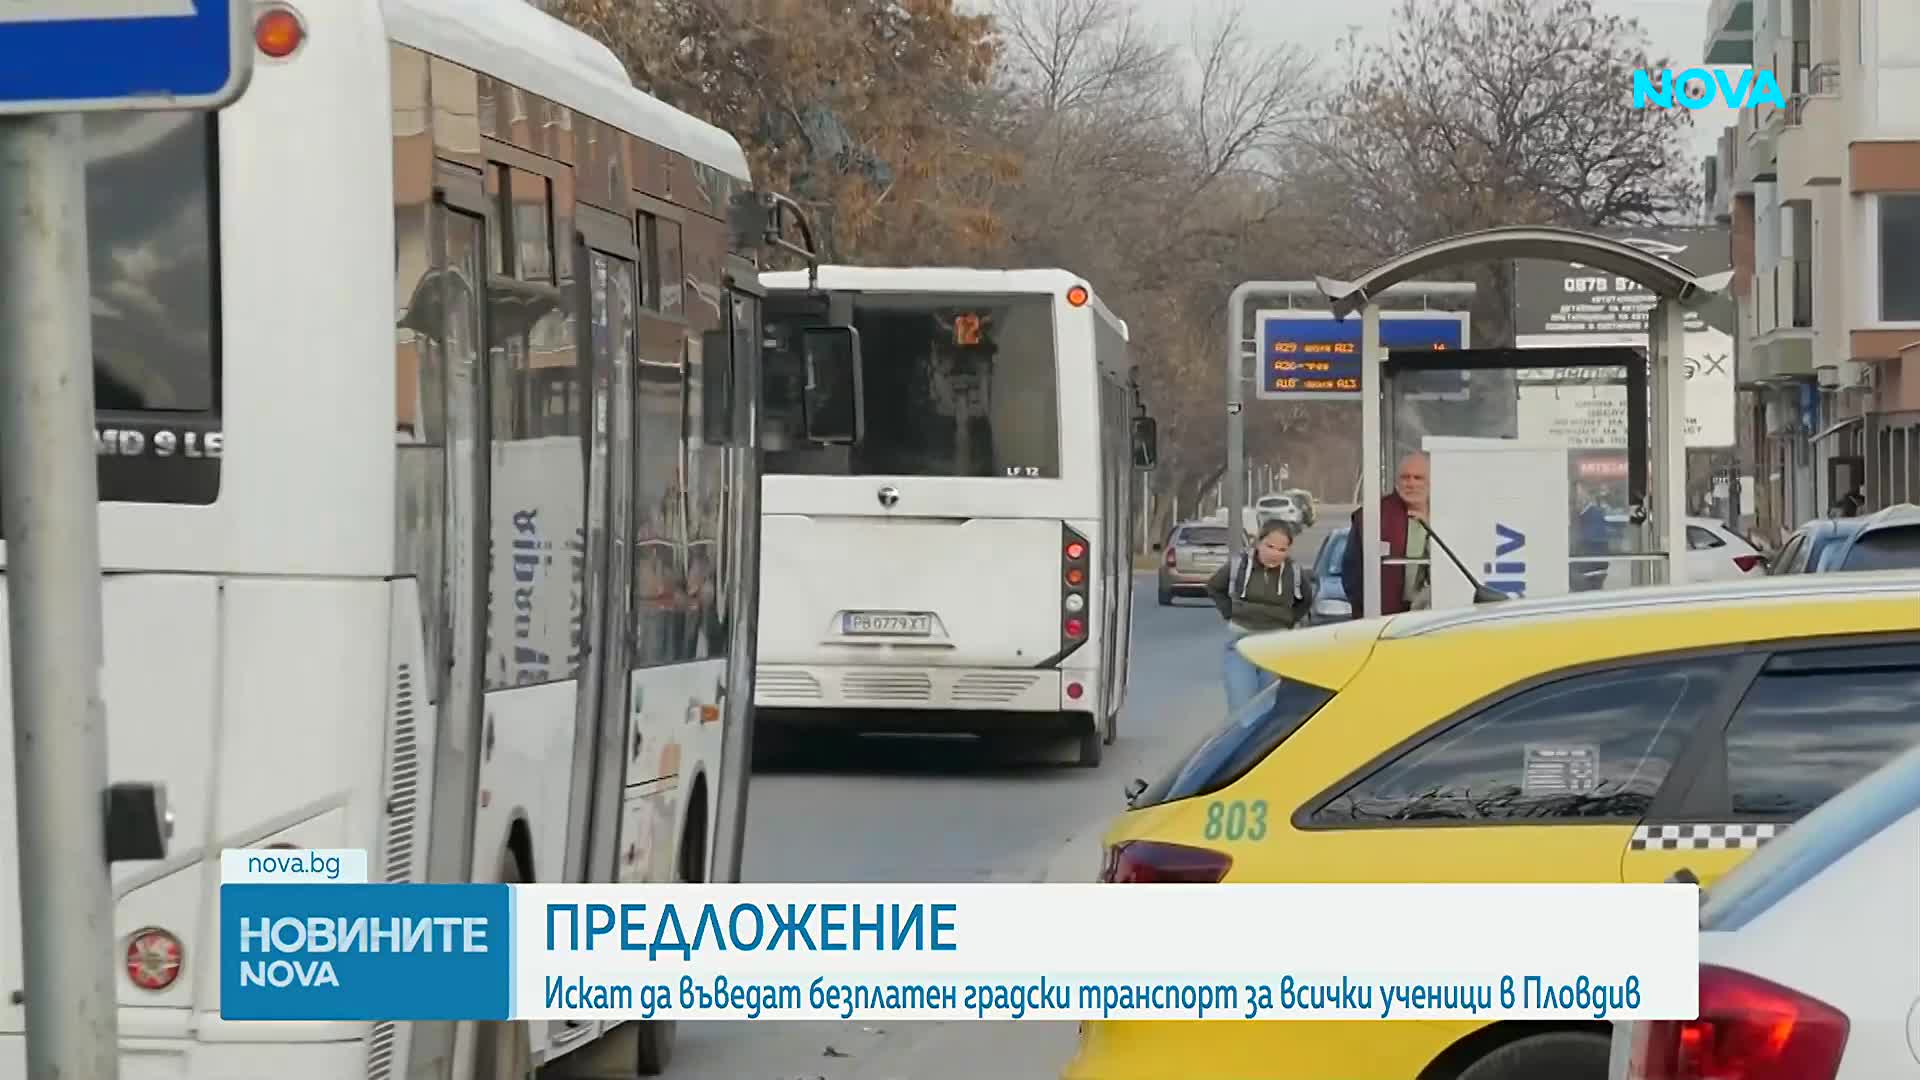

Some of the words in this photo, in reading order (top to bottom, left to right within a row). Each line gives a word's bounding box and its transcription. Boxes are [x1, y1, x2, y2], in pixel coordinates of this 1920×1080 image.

[153, 430, 177, 457] 9
[183, 431, 223, 458] LE
[1026, 466, 1040, 476] 12
[1204, 800, 1268, 841] 803
